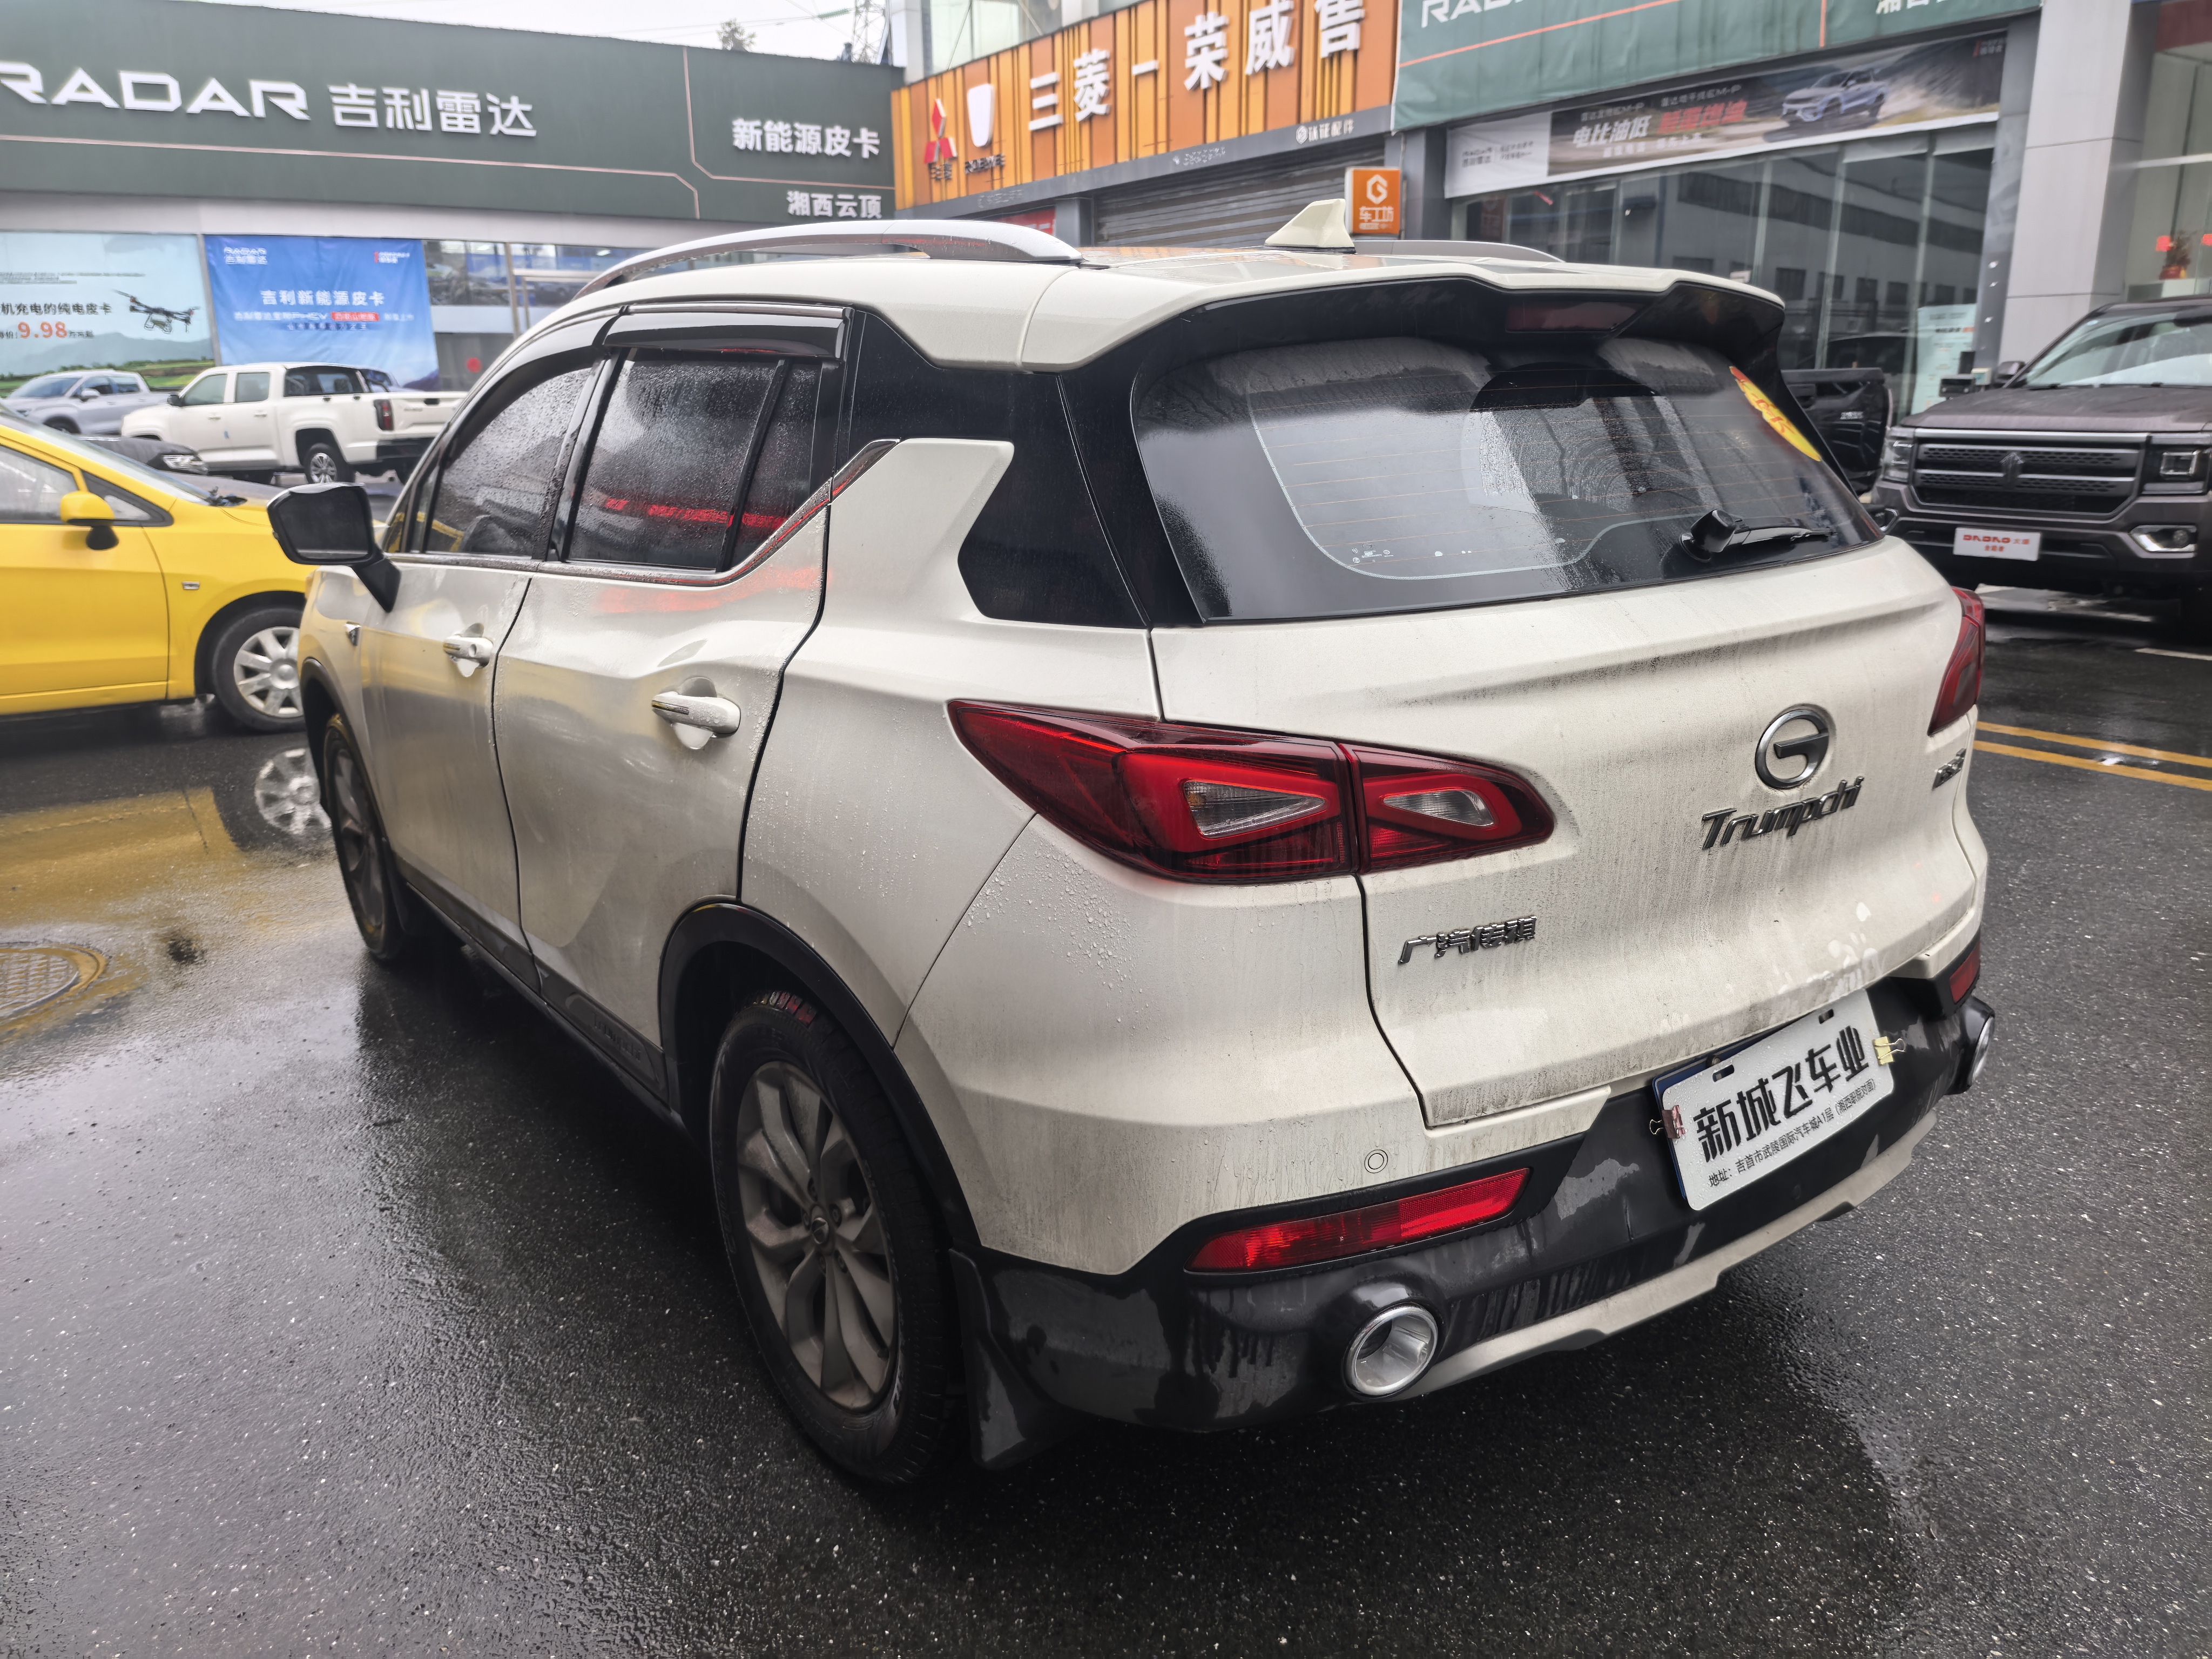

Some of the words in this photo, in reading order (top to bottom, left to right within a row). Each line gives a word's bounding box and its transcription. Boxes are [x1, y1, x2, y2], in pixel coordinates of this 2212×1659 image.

[0, 61, 311, 121] RADAR
[328, 83, 537, 137] 吉利雷达
[732, 118, 881, 159] 新能源皮卡
[786, 190, 882, 219] 湘西云顶
[260, 289, 386, 306] 吉利新能源皮卡
[1702, 776, 1865, 850] Trumpchi
[1398, 915, 1537, 965] 广汽传祺
[1692, 1025, 1869, 1163] 新城飞车业
